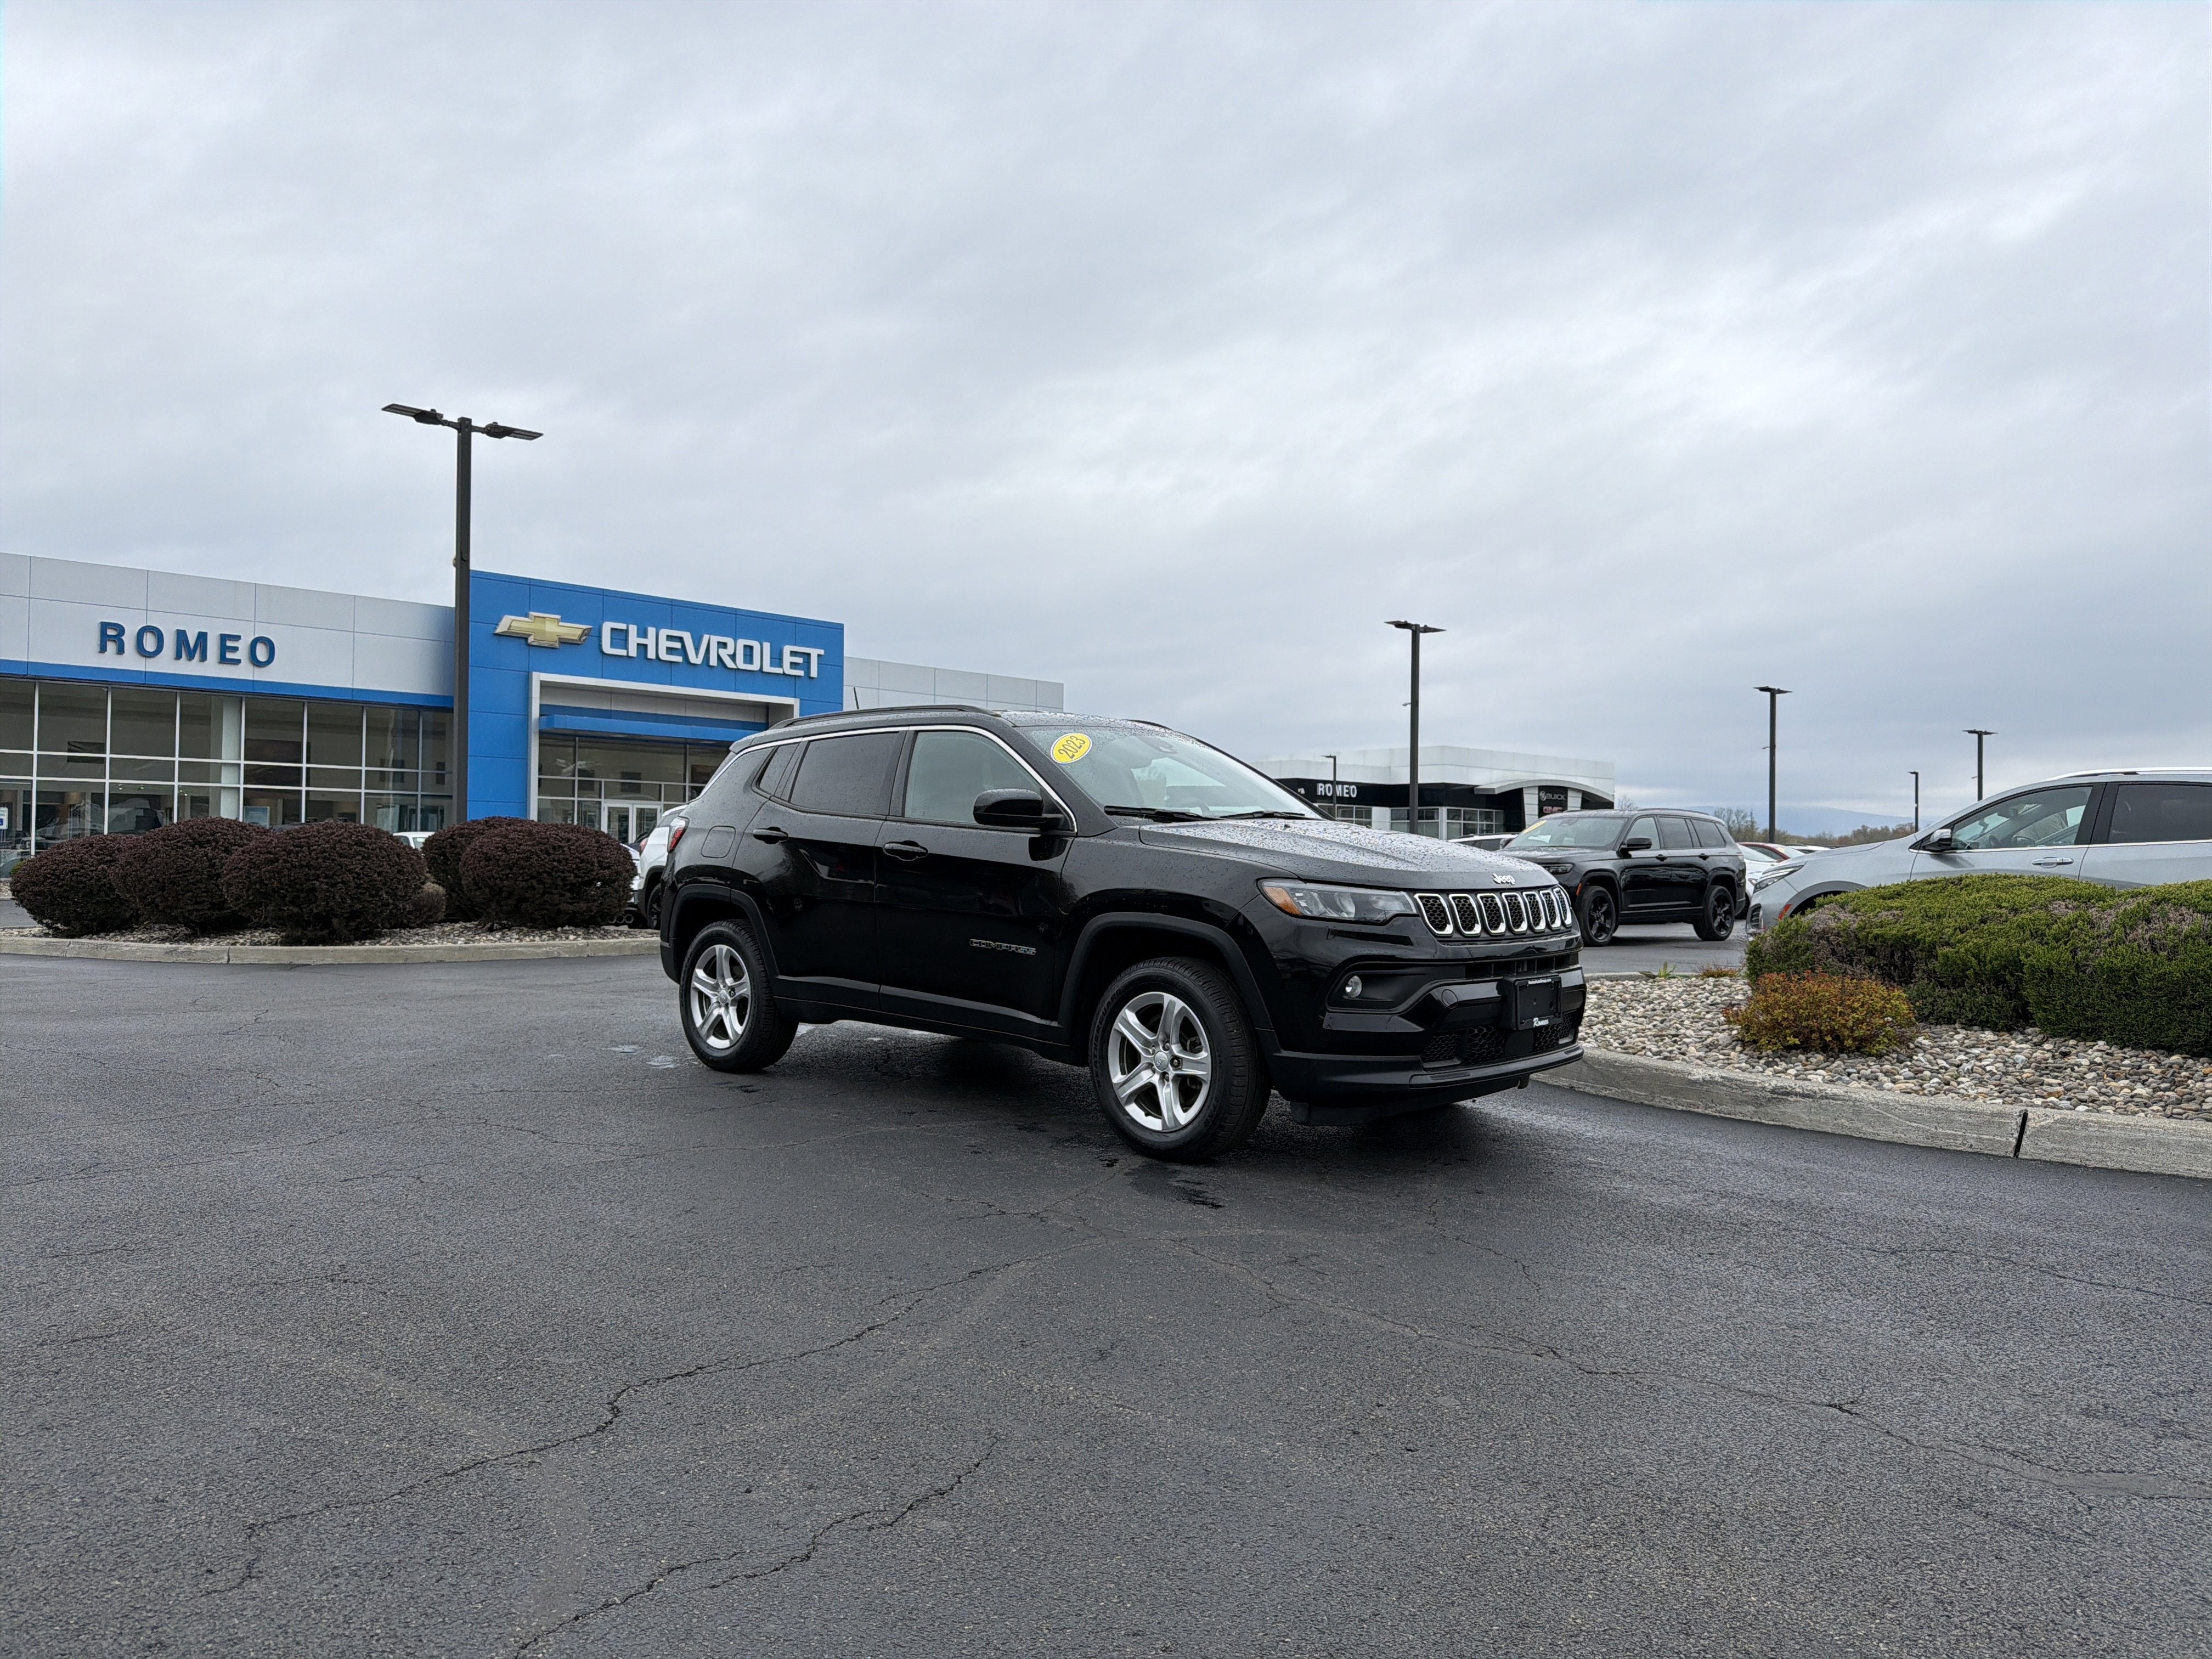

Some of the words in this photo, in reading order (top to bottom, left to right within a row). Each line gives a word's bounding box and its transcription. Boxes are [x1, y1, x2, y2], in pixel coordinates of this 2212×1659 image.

[99, 621, 275, 668] ROMEO
[601, 621, 825, 678] CHEVROLET
[1058, 736, 1086, 759] 2023
[1317, 783, 1357, 798] ROMEO
[1492, 873, 1515, 884] Jeep
[969, 939, 1036, 955] COMPASS
